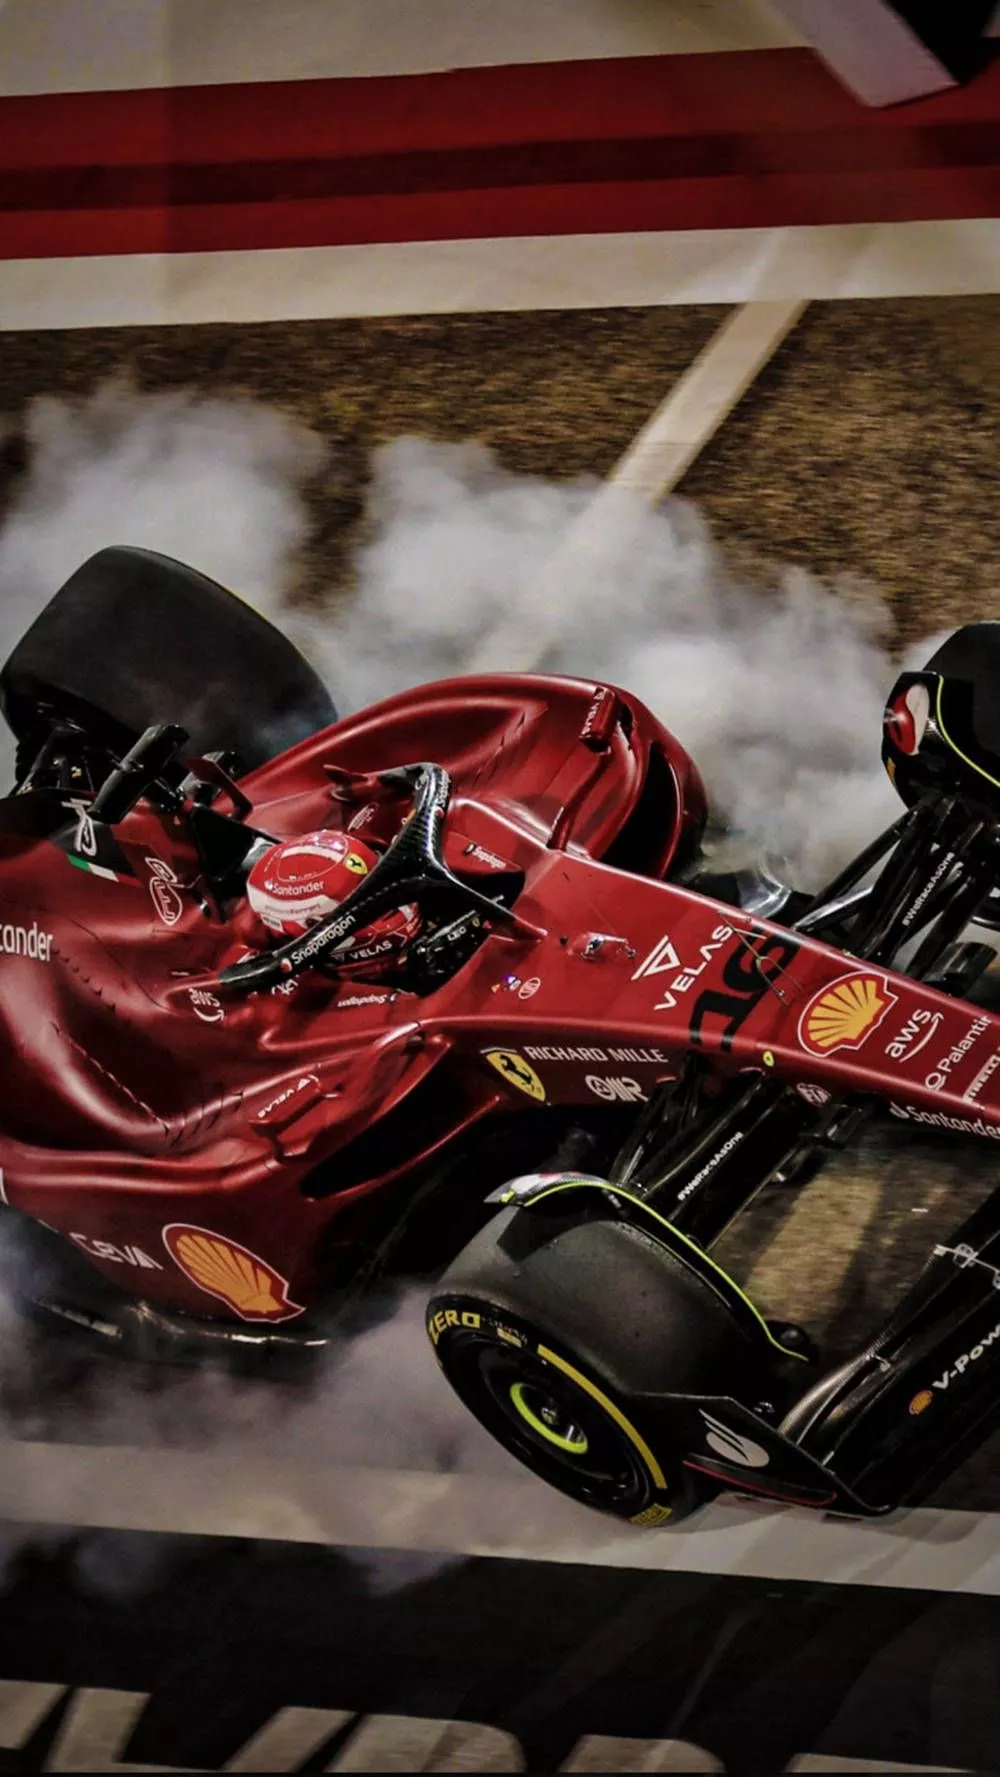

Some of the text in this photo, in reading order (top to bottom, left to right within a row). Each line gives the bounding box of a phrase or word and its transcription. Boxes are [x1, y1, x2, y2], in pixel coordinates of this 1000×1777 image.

[272, 880, 324, 895] Santander
[291, 914, 356, 965] Snapdragon
[349, 939, 392, 960] VELAS
[654, 924, 733, 1010] VELAS
[689, 924, 799, 1052] 16
[524, 1046, 668, 1063] RICHARD MILLE
[885, 1009, 931, 1058] aws
[938, 1016, 991, 1073] Palantir
[428, 1309, 481, 1344] ZERO
